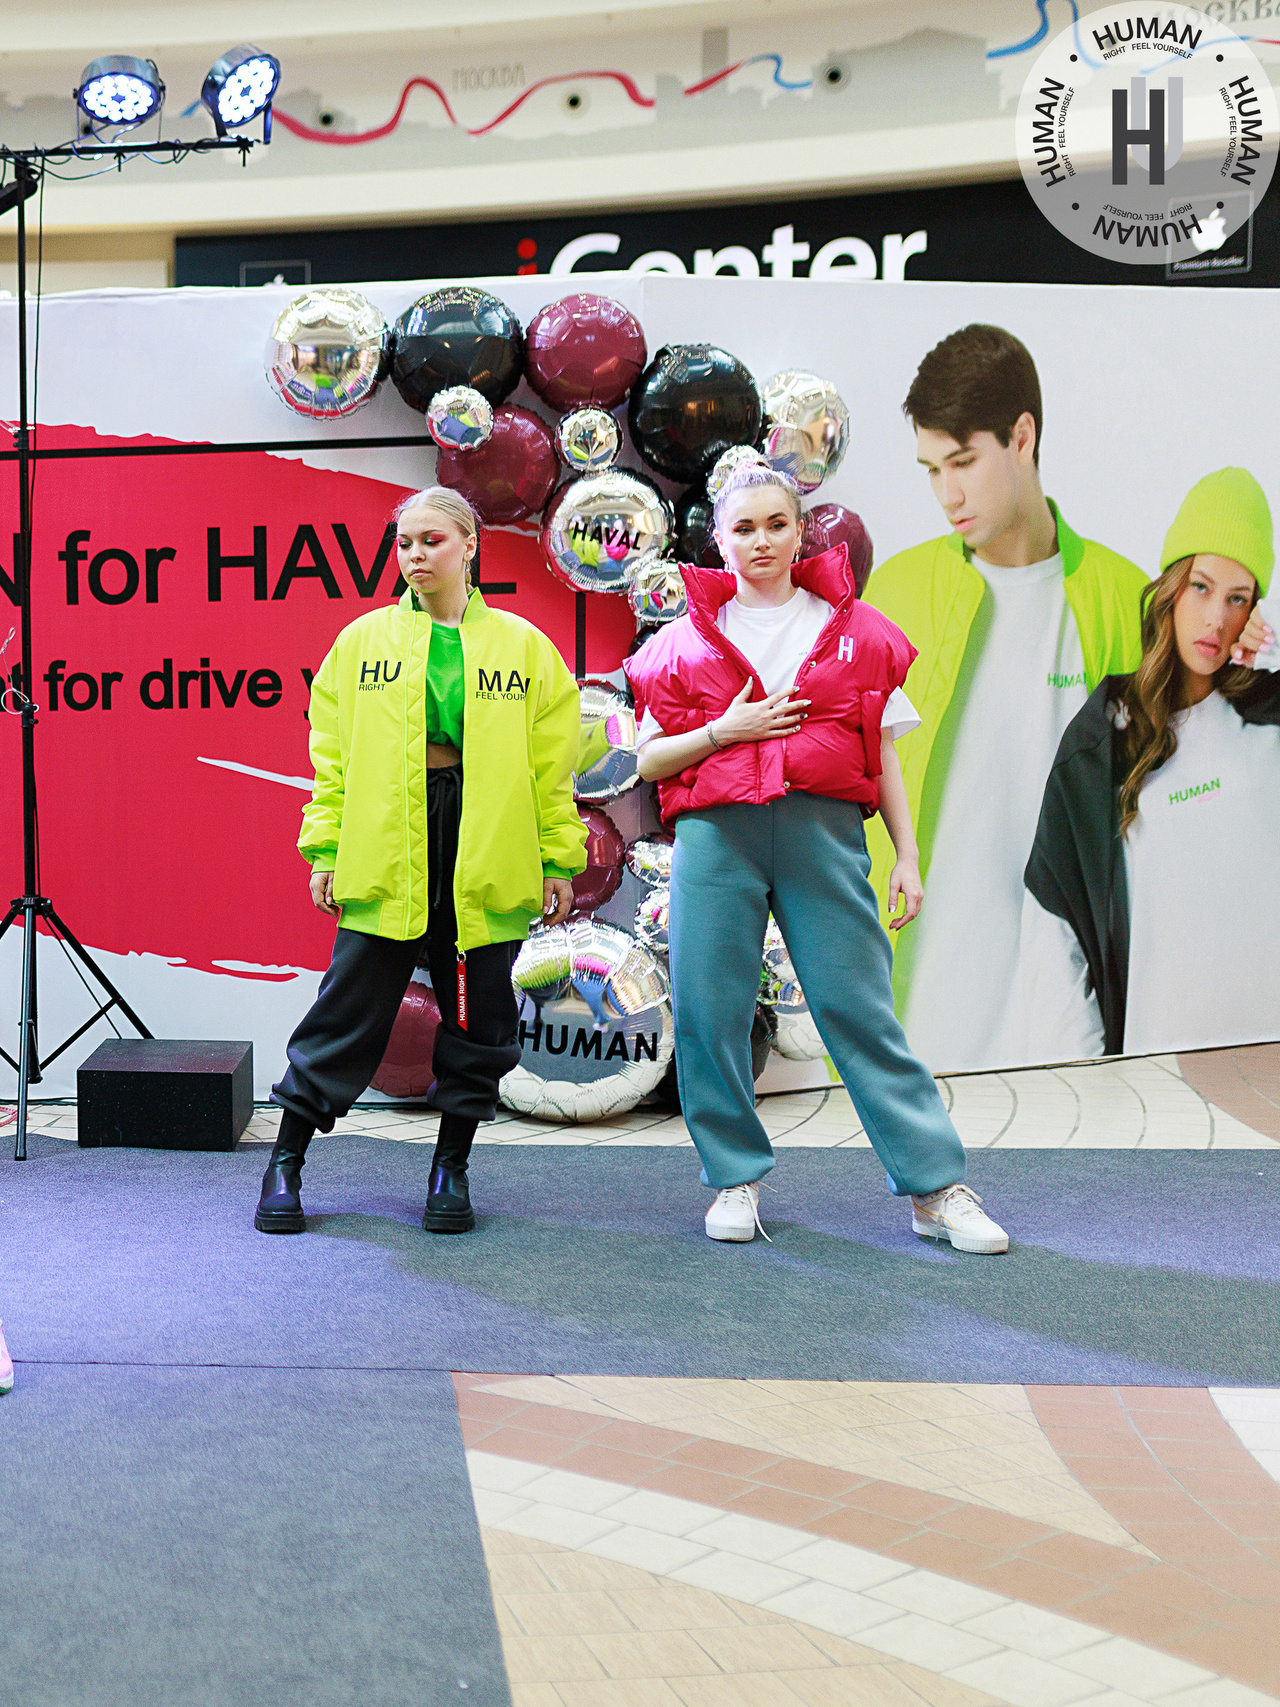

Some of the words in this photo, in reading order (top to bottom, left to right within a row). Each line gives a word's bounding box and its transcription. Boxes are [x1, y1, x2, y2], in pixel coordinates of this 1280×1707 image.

[572, 521, 641, 550] HAVAL
[58, 530, 177, 606] for
[206, 522, 517, 602] HAVL
[42, 660, 123, 712] for
[139, 657, 283, 709] drive
[360, 660, 402, 683] HU
[476, 691, 498, 700] FEEL
[501, 692, 526, 702] YOUR
[1168, 778, 1221, 805] HUMAN
[519, 1020, 658, 1062] HUMAN
